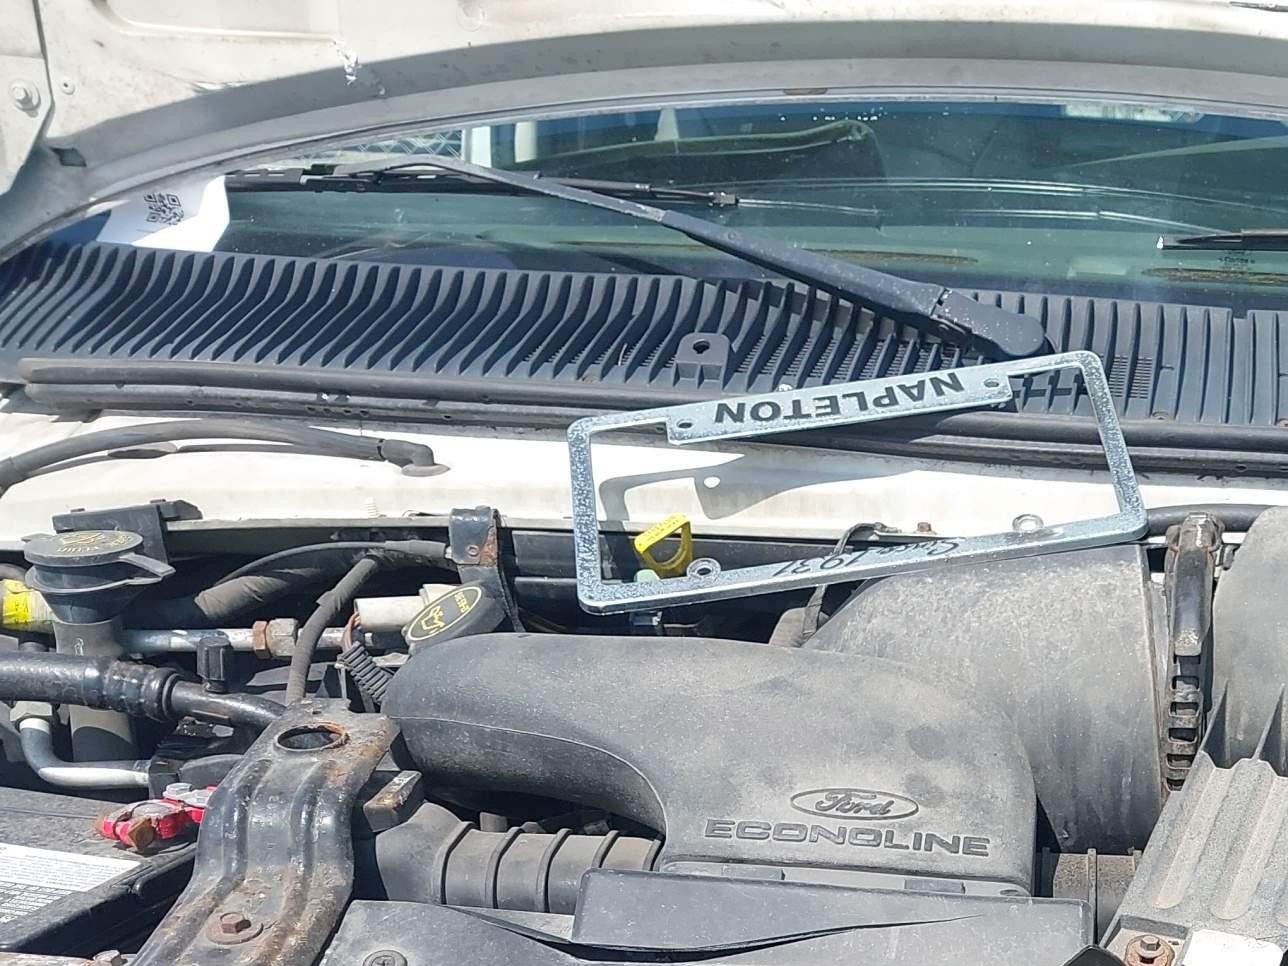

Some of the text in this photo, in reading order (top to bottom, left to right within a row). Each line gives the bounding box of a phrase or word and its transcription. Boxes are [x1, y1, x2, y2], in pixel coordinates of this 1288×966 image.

[715, 371, 965, 424] NAPLETON
[815, 791, 895, 815] Ford
[704, 819, 990, 857] ECONOLINE
